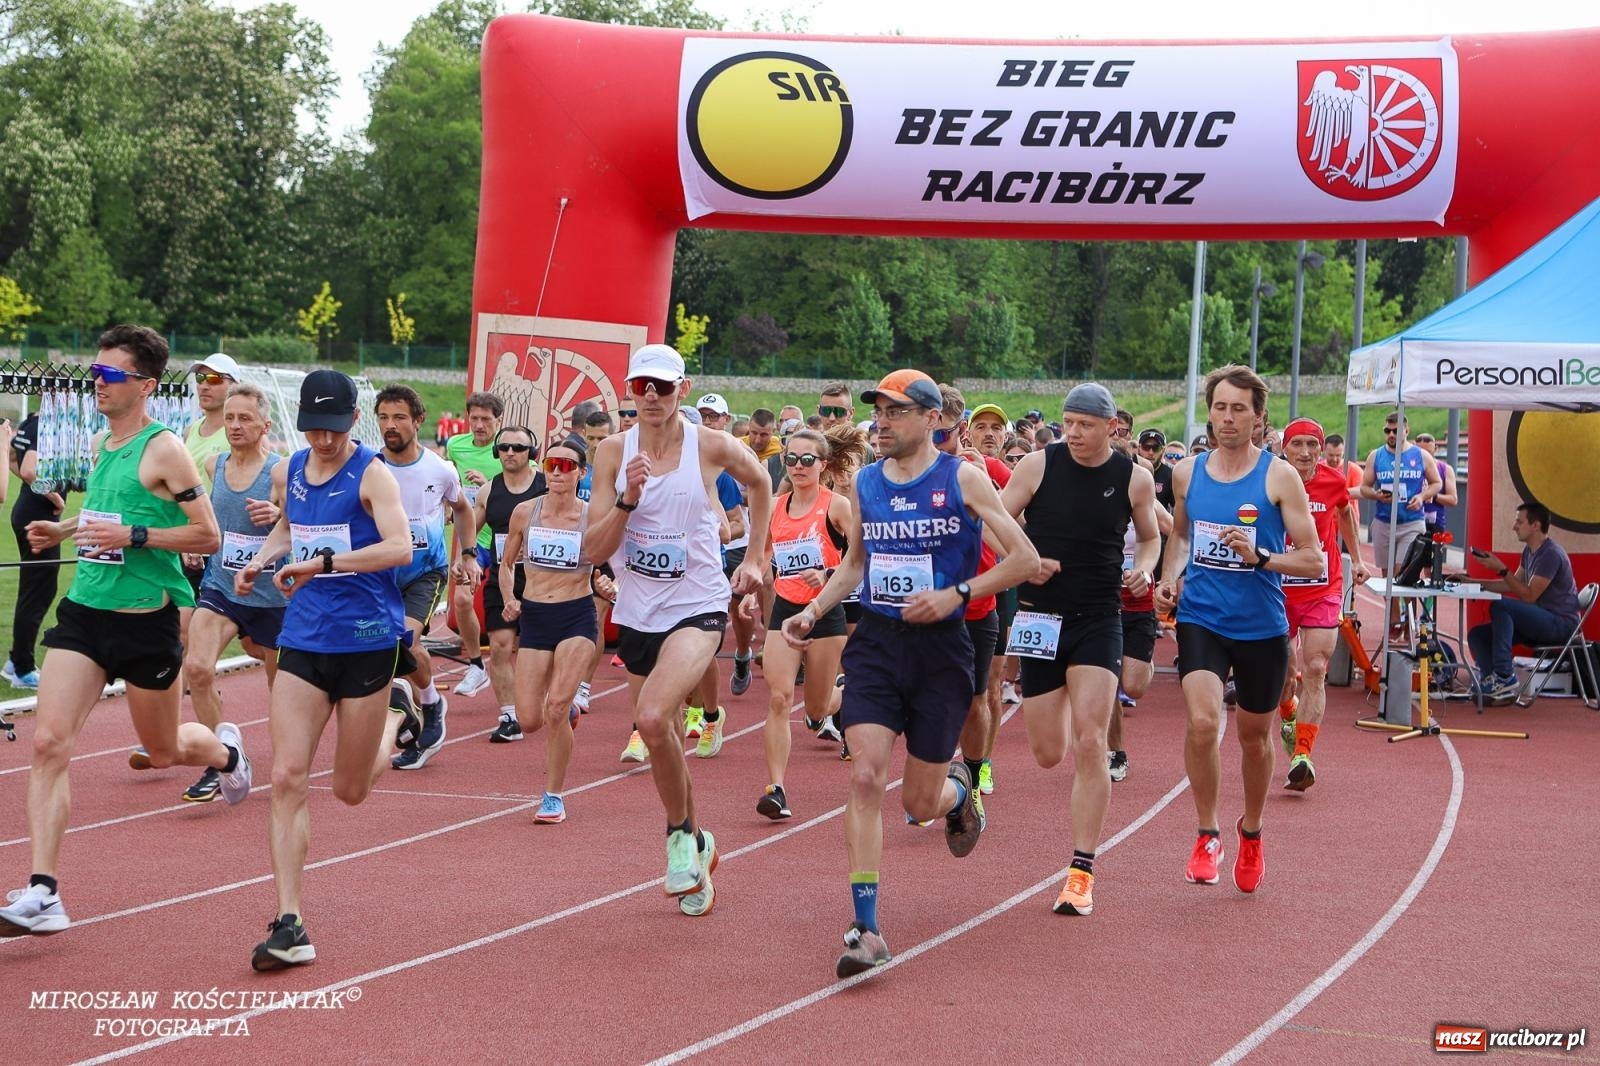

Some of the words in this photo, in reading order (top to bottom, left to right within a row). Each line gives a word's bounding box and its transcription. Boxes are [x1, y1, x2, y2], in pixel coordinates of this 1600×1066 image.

[996, 60, 1136, 88] BIEG
[768, 72, 850, 102] SIR
[895, 108, 1013, 146] BEZ
[1020, 110, 1236, 148] GRANIC
[921, 161, 1206, 205] RACIBÓRZ
[862, 516, 960, 540] RUNNERS
[541, 543, 565, 558] 173
[919, 540, 941, 548] TEAM
[236, 549, 258, 562] 24
[636, 550, 670, 569] 220
[787, 553, 810, 568] 210
[882, 575, 914, 593] 163
[1018, 630, 1042, 645] 193
